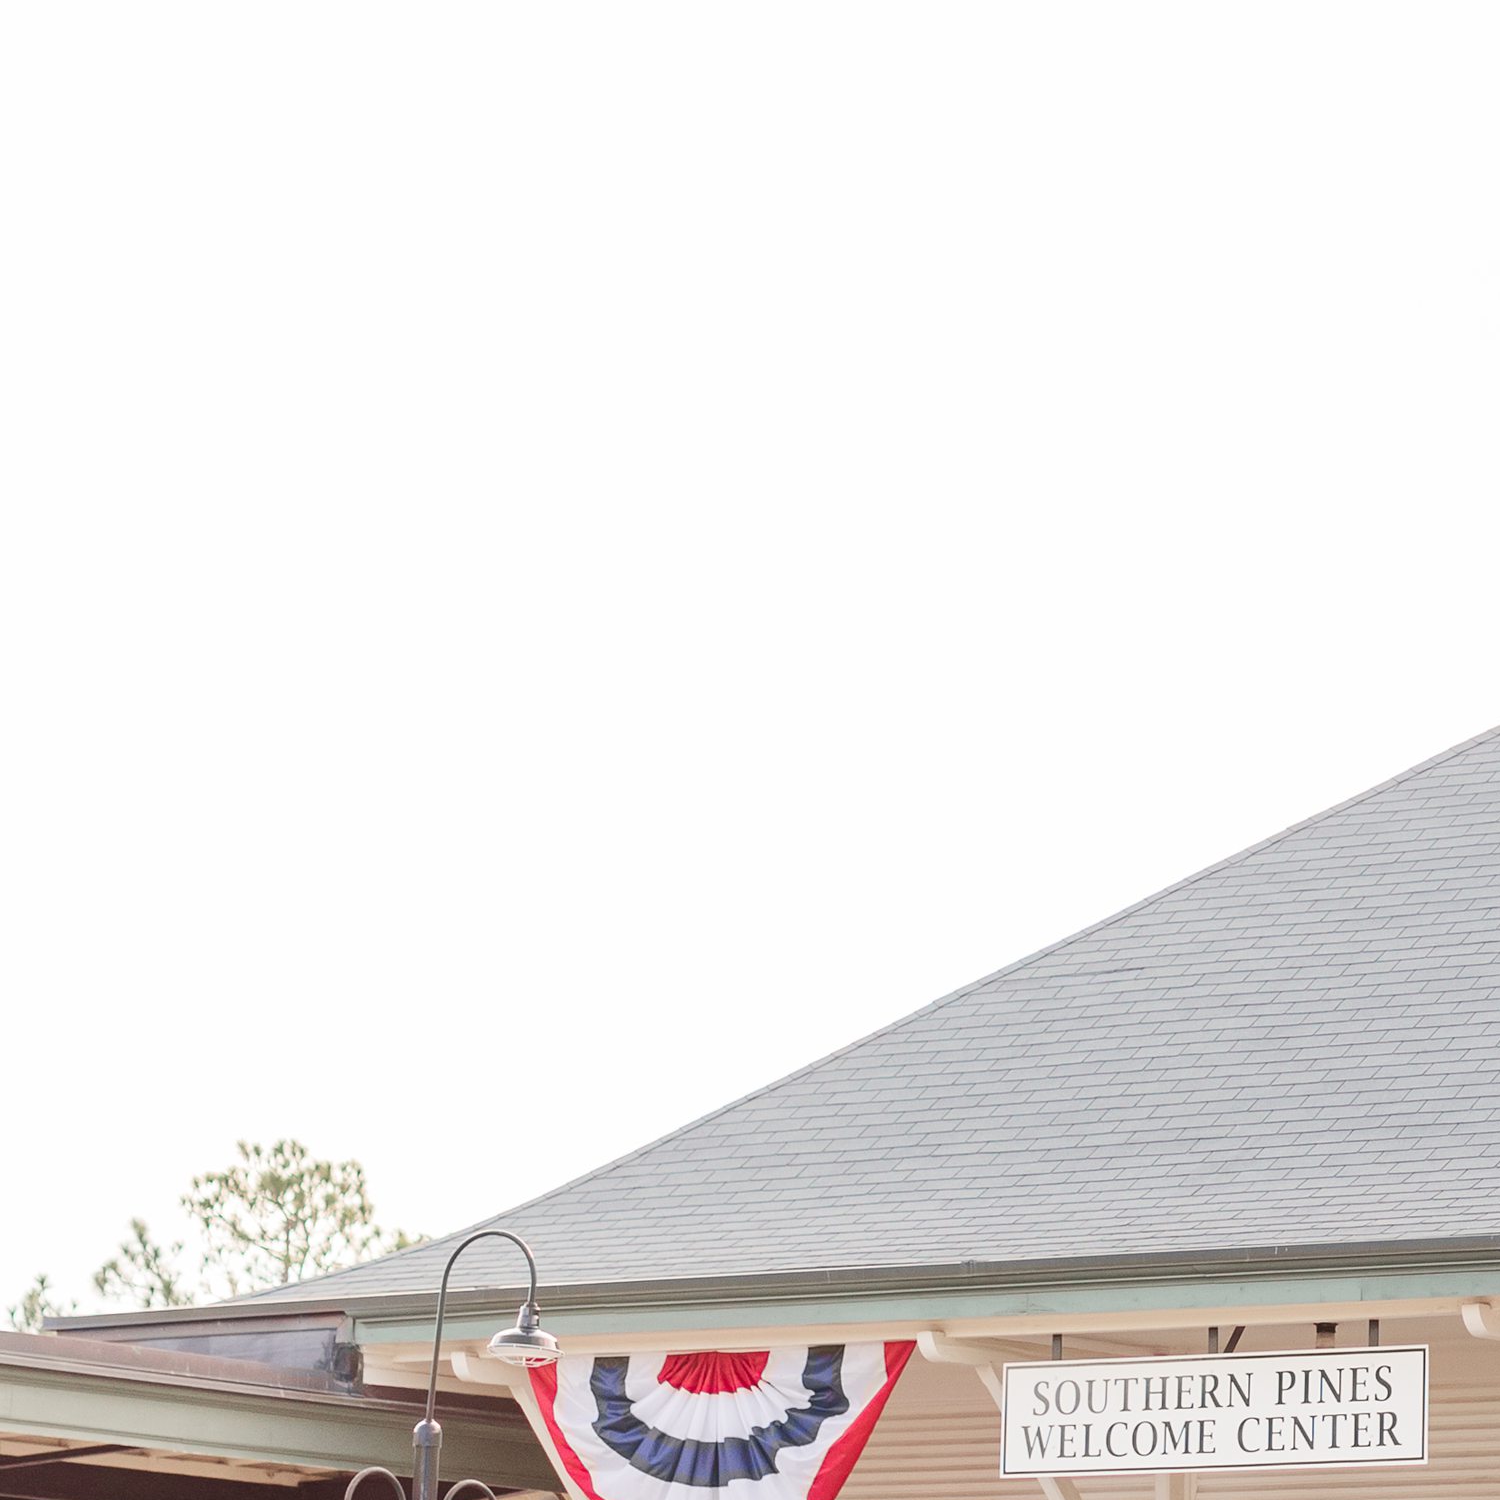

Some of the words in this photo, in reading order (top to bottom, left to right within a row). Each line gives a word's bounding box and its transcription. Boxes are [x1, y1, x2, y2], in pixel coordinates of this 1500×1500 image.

[1032, 1372, 1254, 1417] SOUTHERN
[1274, 1364, 1393, 1406] PINES
[1021, 1419, 1217, 1460] WELCOME
[1237, 1411, 1403, 1453] CENTER
